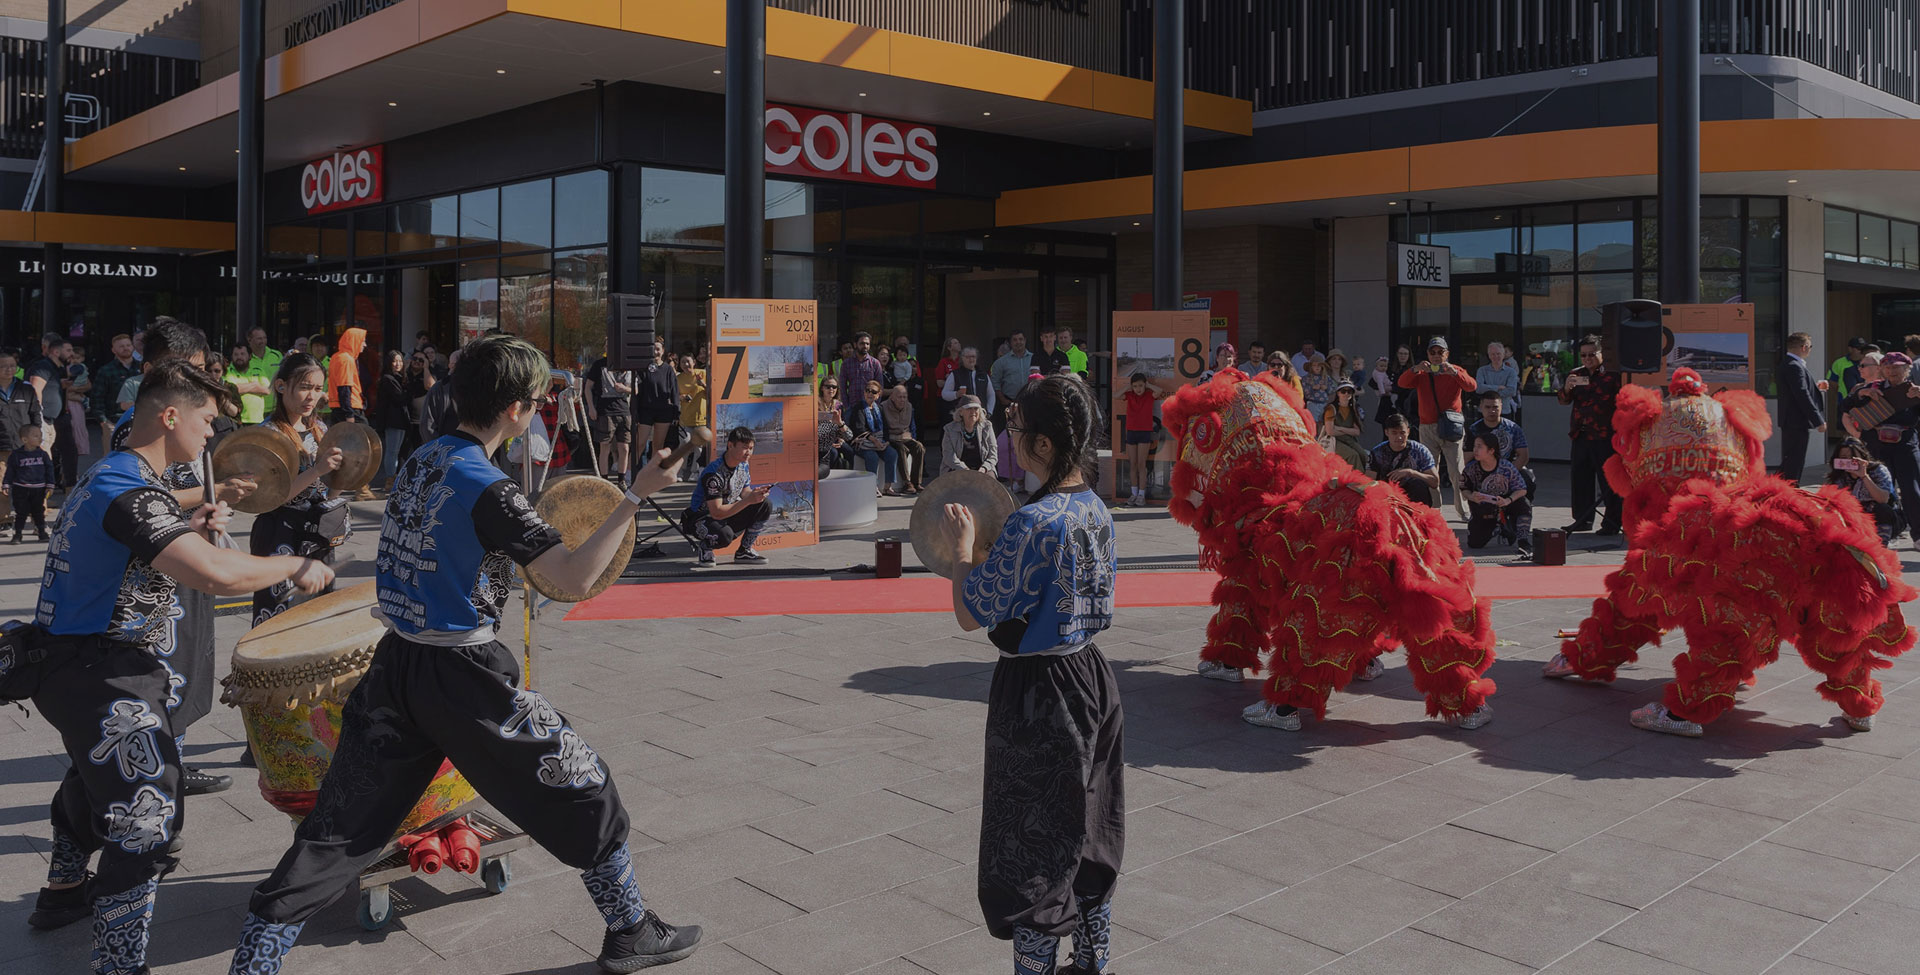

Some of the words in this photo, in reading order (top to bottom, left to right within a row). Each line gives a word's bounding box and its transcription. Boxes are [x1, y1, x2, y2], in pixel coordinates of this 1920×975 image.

[764, 107, 938, 182] coles
[301, 149, 373, 210] coles
[1406, 249, 1435, 268] SUSHI
[19, 259, 158, 278] LIUORLAND
[1407, 264, 1442, 282] &MORE
[768, 304, 790, 314] TIME
[793, 304, 814, 314] LINE
[786, 319, 814, 332] 2021
[796, 333, 814, 342] JULY
[1178, 338, 1205, 379] 8
[716, 346, 747, 400] 7
